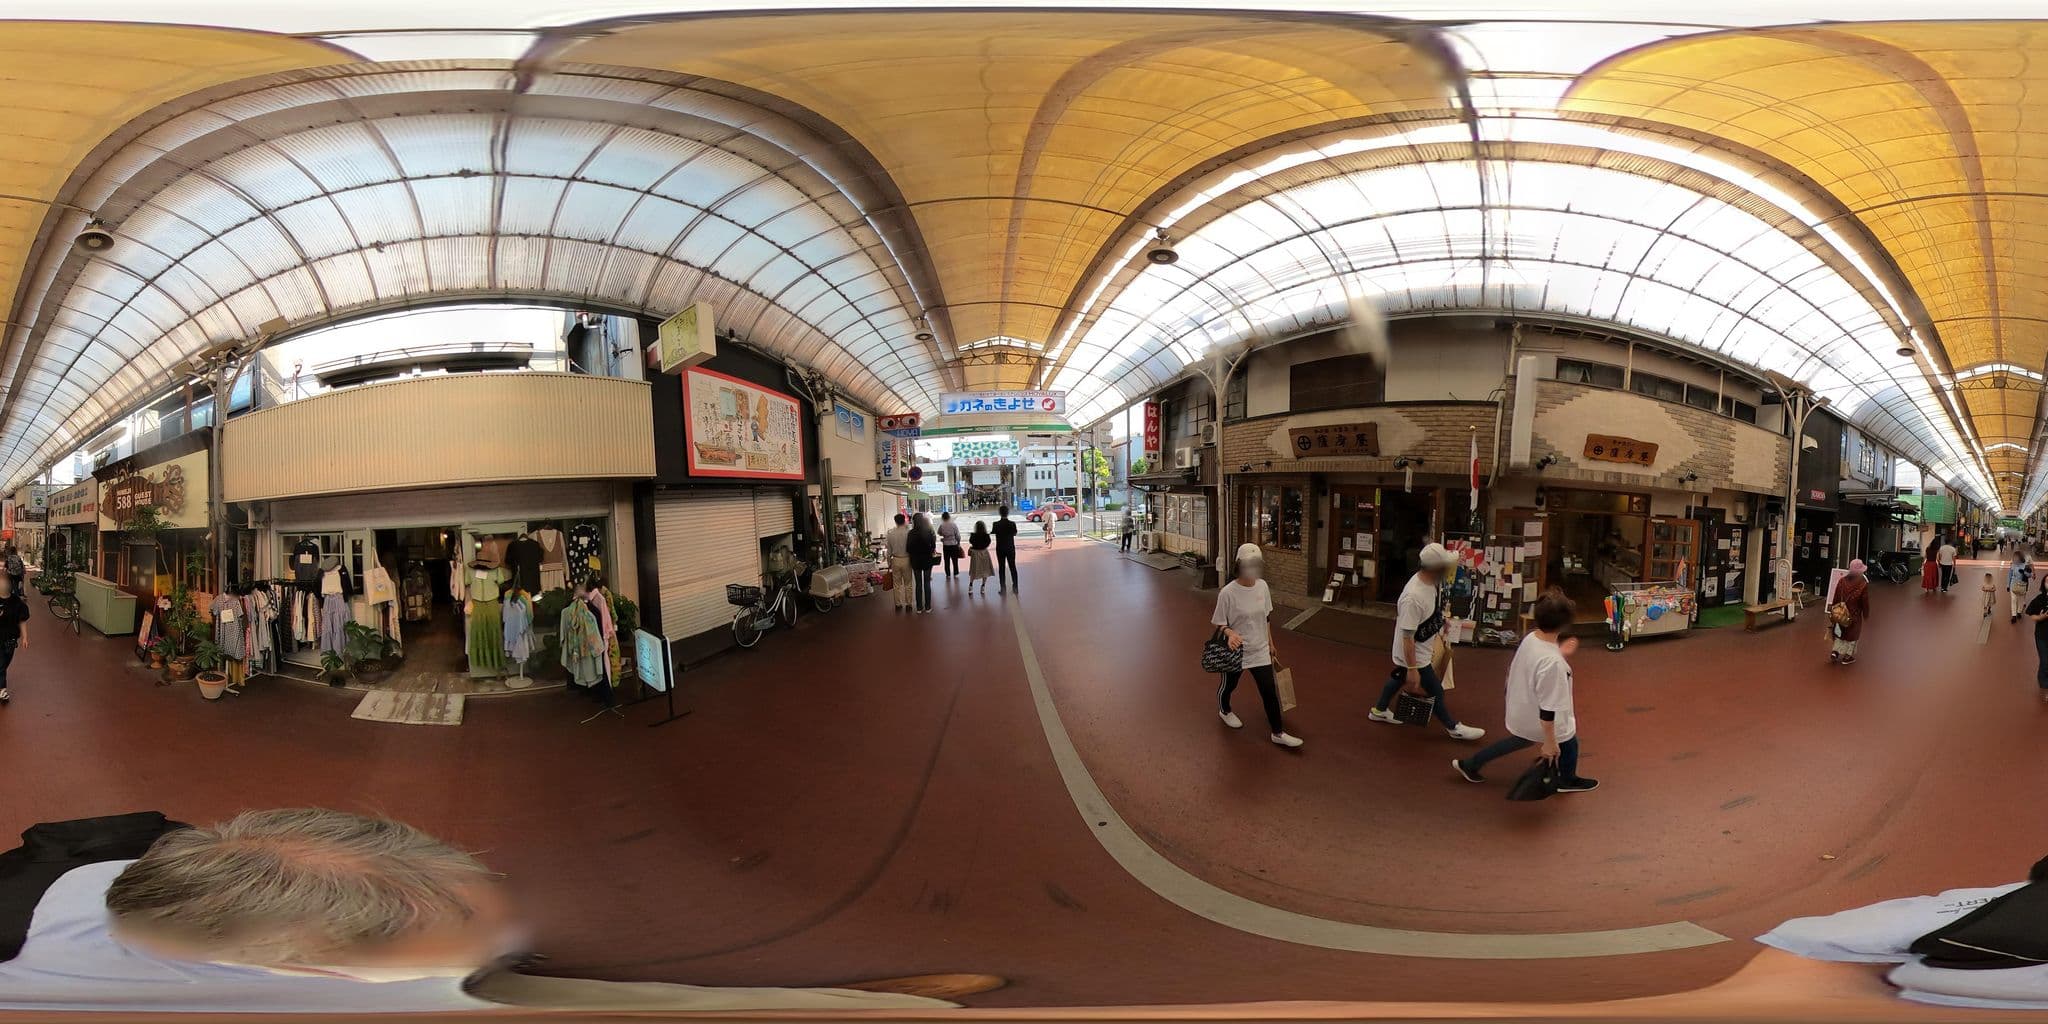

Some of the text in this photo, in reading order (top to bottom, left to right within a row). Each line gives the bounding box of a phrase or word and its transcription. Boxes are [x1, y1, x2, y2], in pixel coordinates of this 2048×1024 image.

[1147, 406, 1158, 448] はんや
[881, 440, 892, 477] きよせ
[116, 495, 132, 510] 588
[134, 490, 152, 499] GUEST
